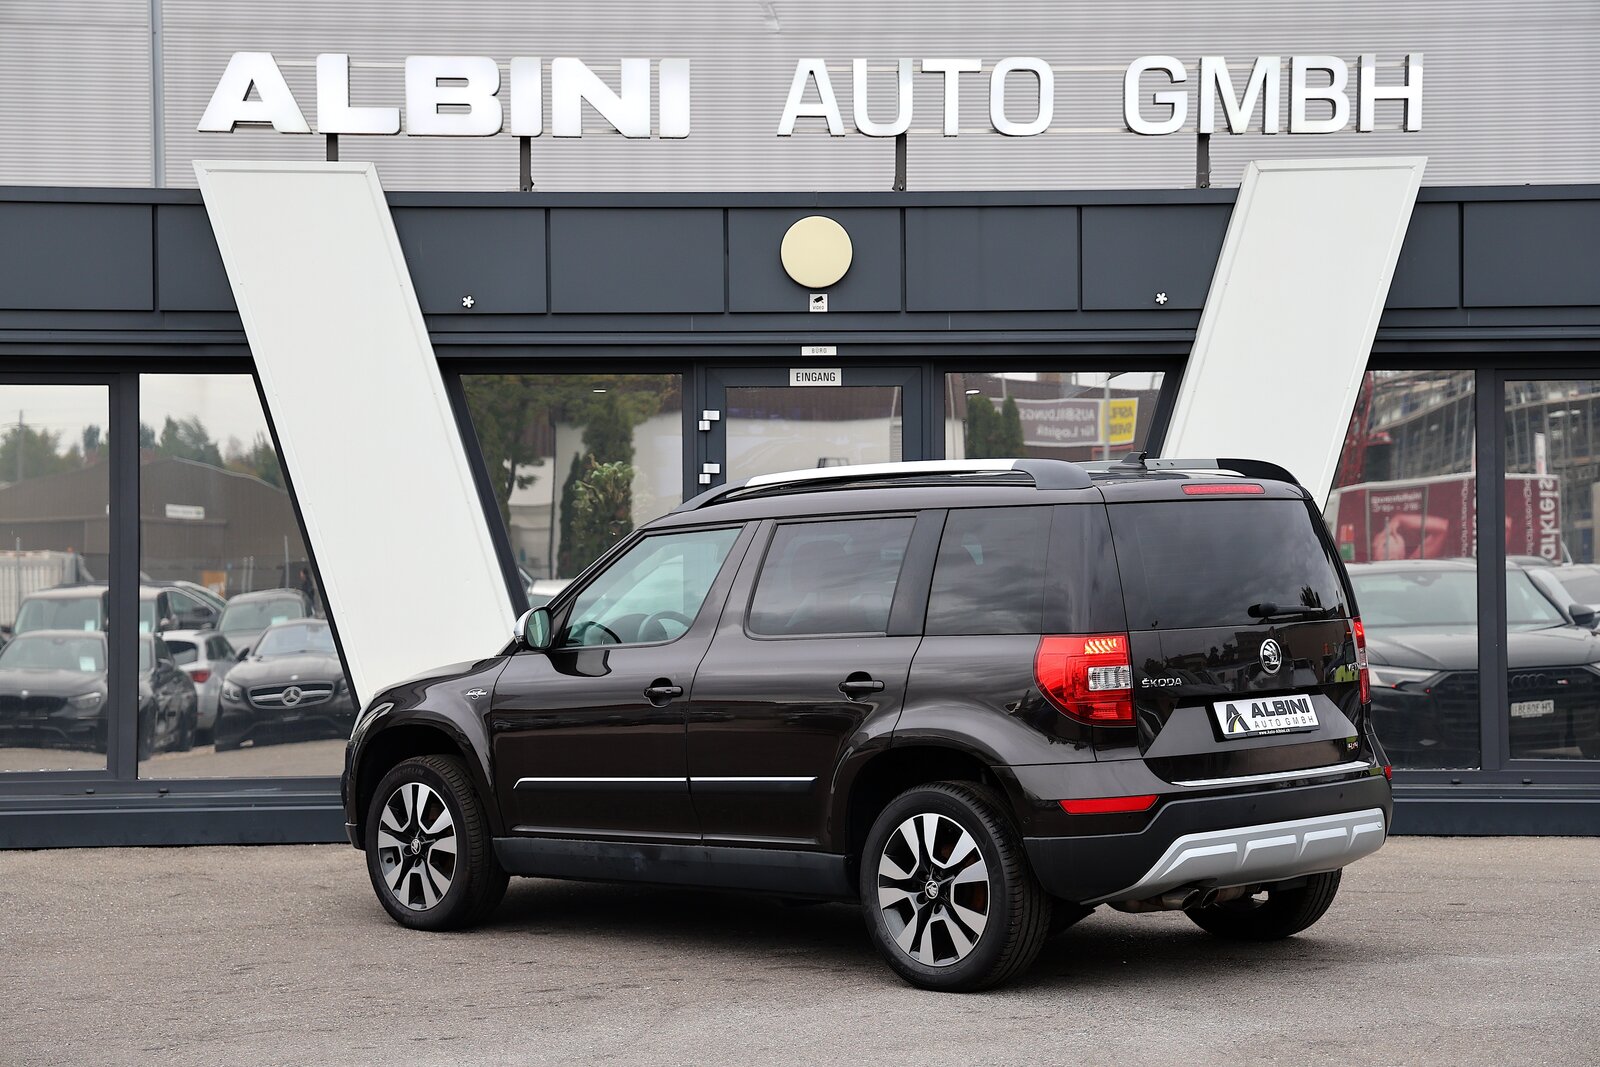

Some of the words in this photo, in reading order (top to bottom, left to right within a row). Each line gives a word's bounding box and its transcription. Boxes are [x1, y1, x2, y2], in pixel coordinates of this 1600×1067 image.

[197, 51, 691, 139] ALBINI
[777, 57, 1055, 137] AUTO
[1122, 53, 1424, 134] GMBH
[796, 372, 836, 382] EINGANG
[1141, 677, 1182, 688] ŠKODA
[1251, 698, 1310, 718] ALBINI
[1254, 718, 1281, 728] AUTO
[1285, 715, 1315, 726] GMBH
